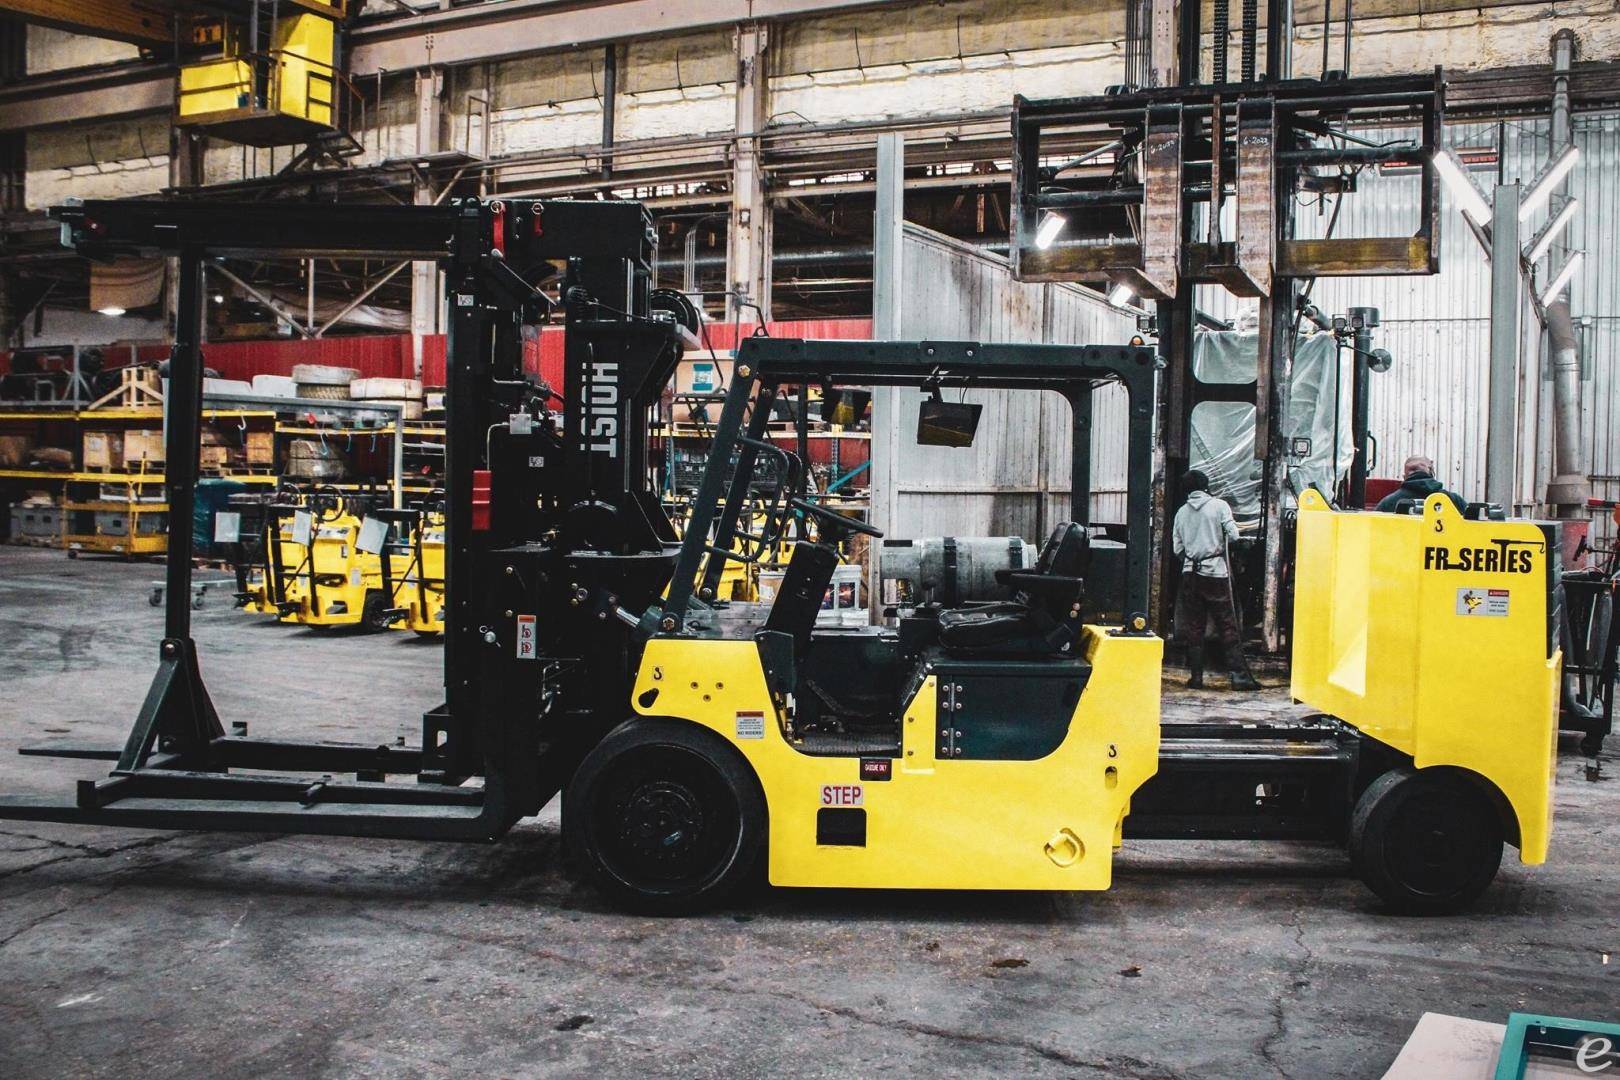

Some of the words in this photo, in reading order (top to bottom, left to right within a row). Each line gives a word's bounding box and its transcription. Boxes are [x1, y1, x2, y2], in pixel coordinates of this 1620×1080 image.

[580, 362, 618, 458] HOIST
[1424, 546, 1449, 571] FR
[1459, 540, 1533, 574] SERIES
[823, 786, 861, 804] STEP
